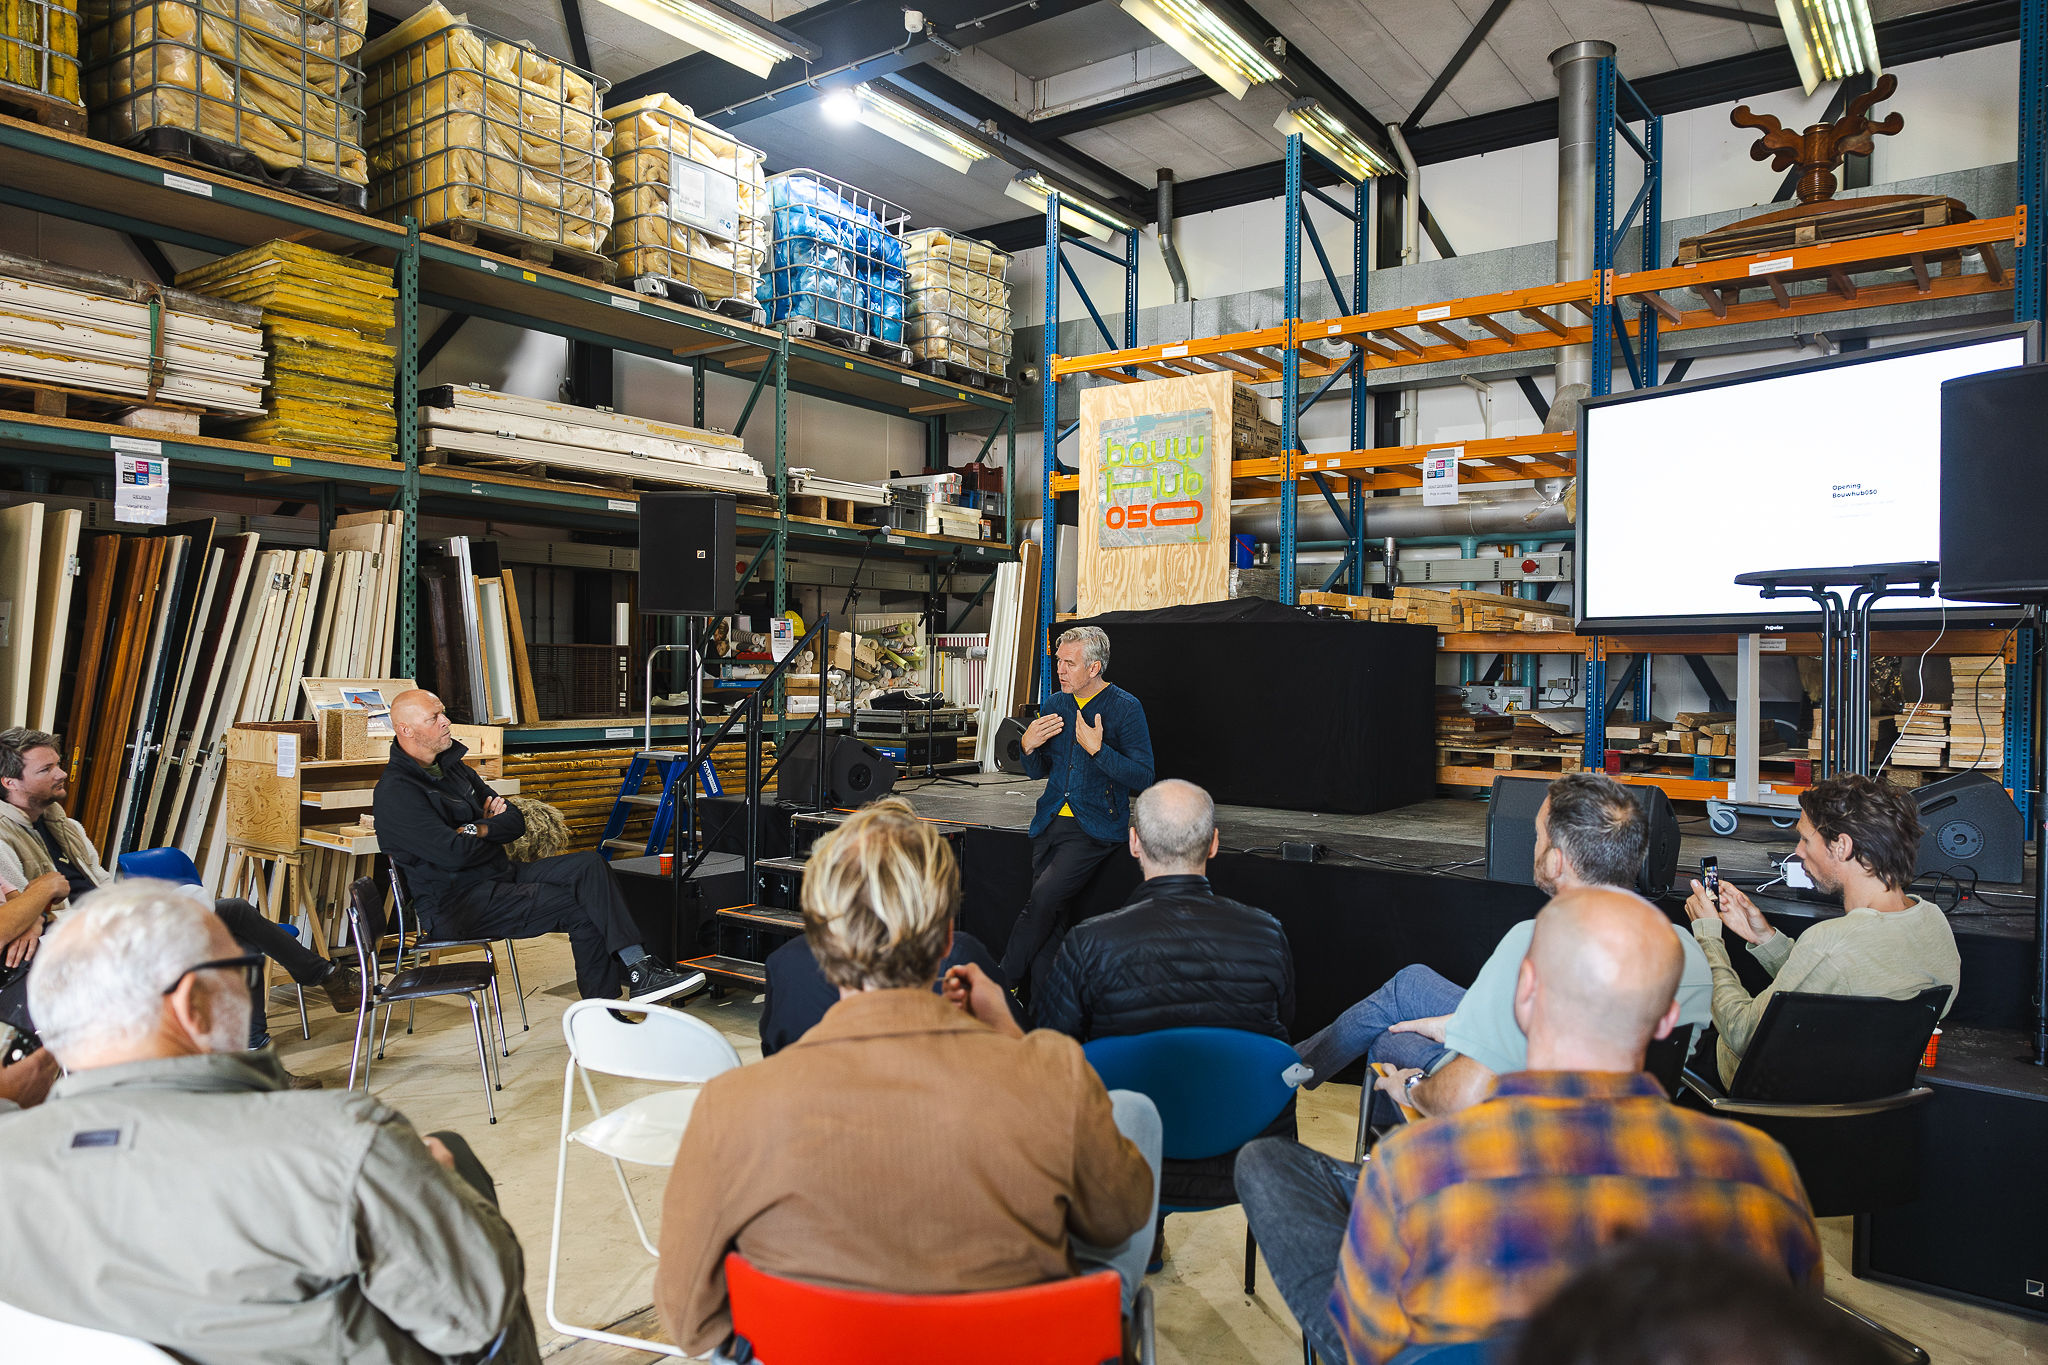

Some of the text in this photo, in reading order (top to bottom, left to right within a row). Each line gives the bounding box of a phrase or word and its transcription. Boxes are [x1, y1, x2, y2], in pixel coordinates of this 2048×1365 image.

[1107, 435, 1204, 466] bouw
[1106, 464, 1204, 503] Hub
[1832, 483, 1861, 491] Opening
[1832, 489, 1878, 498] Bouwhub050
